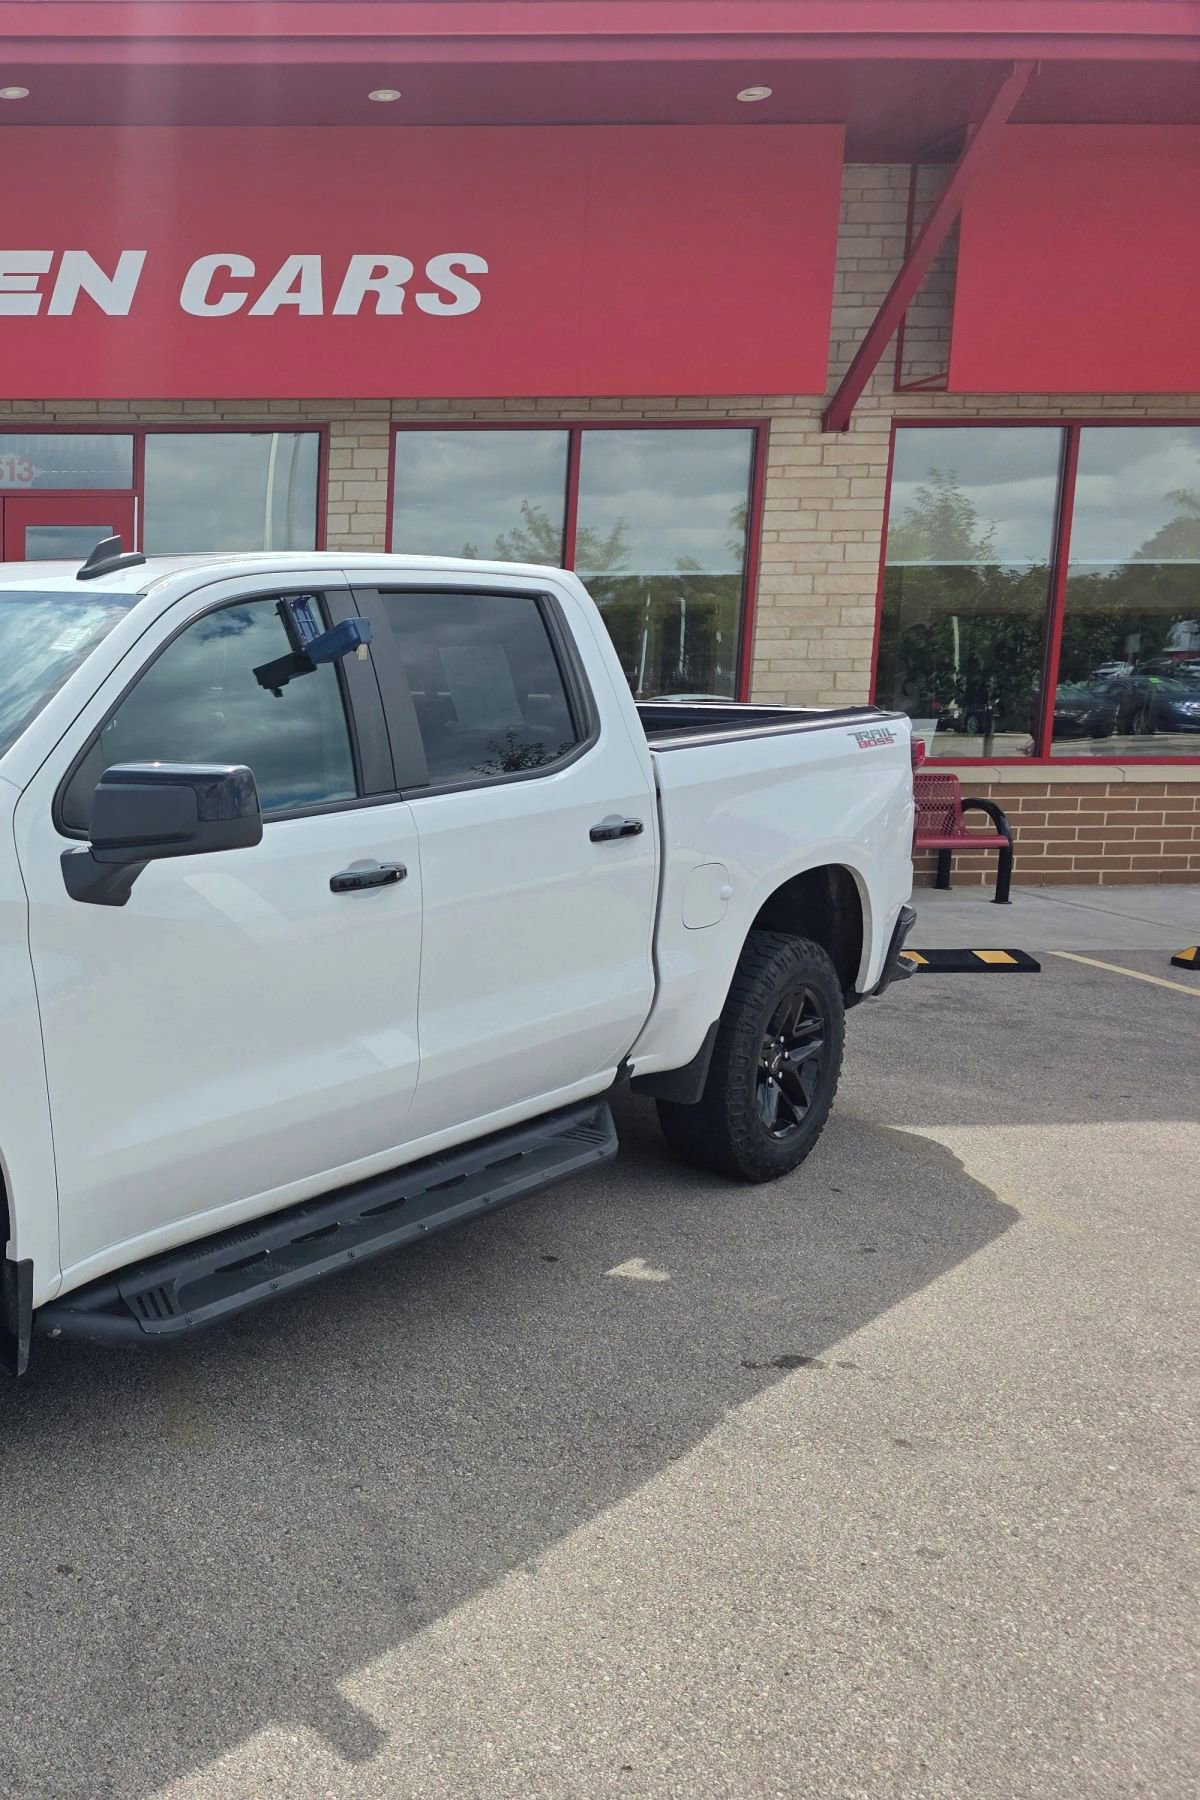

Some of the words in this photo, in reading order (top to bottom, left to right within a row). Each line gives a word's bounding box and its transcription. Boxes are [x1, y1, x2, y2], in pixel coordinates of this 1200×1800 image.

[179, 252, 489, 317] CARS
[847, 727, 897, 742] TRAIL
[858, 736, 895, 749] BOSS
